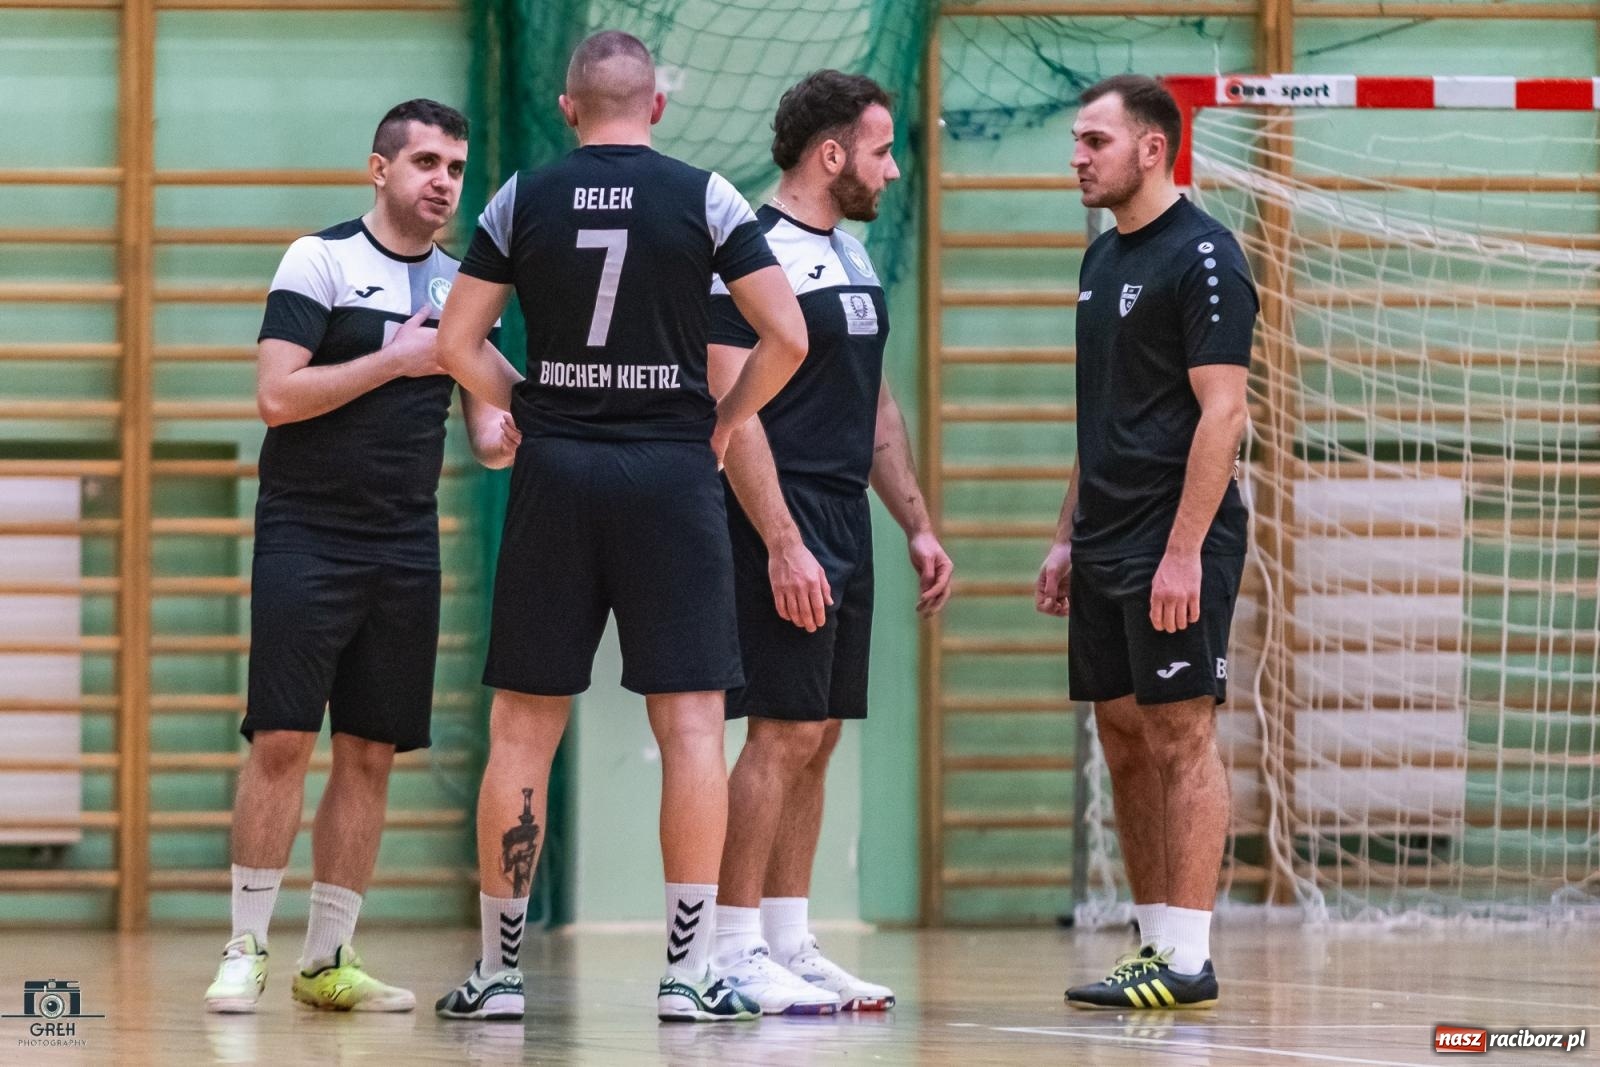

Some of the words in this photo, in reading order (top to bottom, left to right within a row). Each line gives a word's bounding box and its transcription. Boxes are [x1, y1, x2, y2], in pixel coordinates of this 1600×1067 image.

[1281, 84, 1330, 100] sport
[573, 187, 634, 209] BELEK
[576, 229, 628, 346] 7
[540, 361, 612, 388] BIOCHEM
[617, 364, 681, 389] KIETRZ
